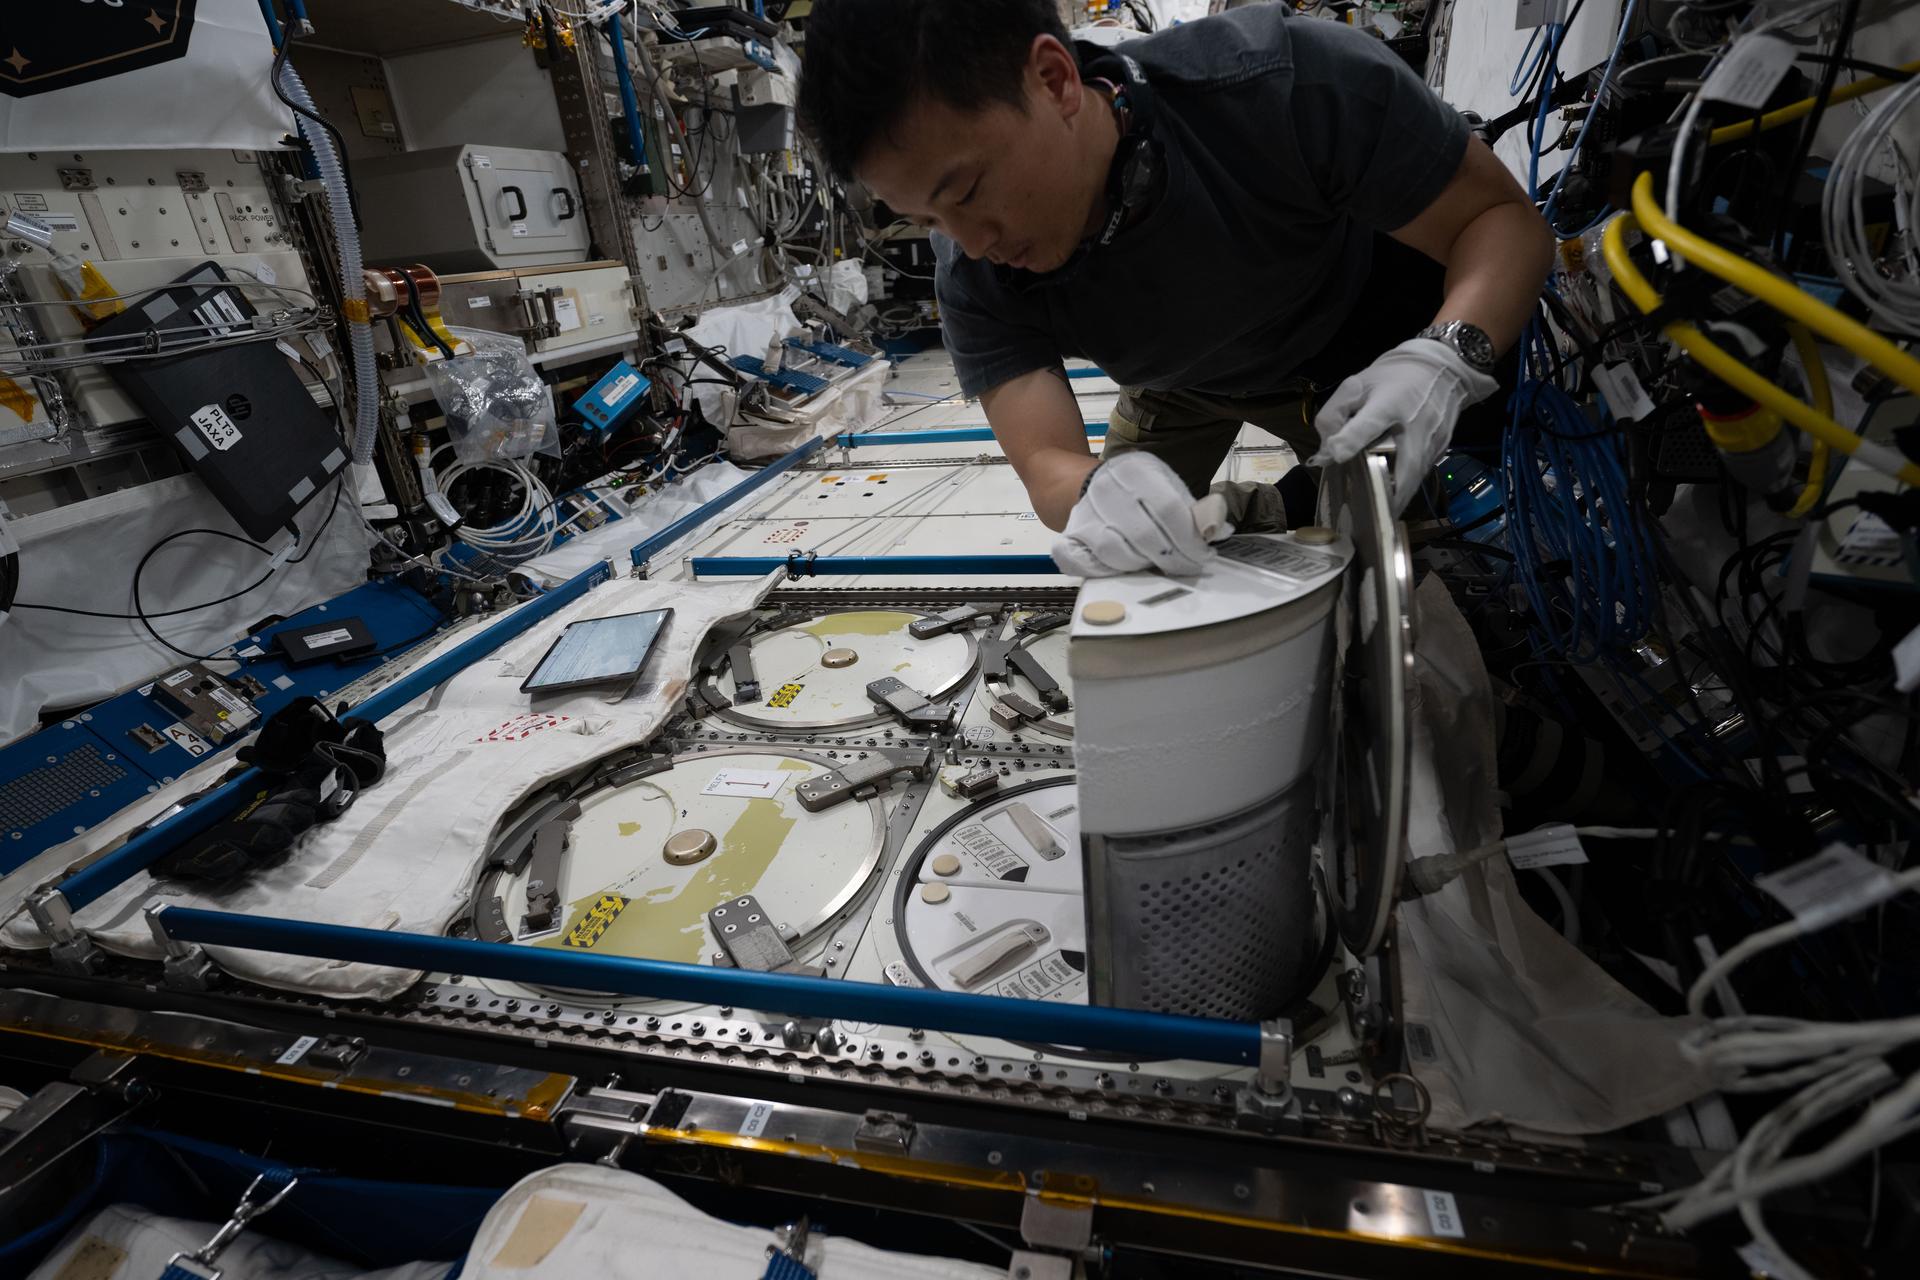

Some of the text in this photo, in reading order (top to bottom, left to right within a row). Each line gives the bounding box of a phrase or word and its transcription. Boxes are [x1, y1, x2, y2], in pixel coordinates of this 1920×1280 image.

[1100, 206, 1123, 245] PETZL
[198, 417, 225, 447] JAXA
[209, 408, 235, 437] PLT3
[170, 727, 205, 756] A 4 D
[753, 1105, 767, 1118] C2
